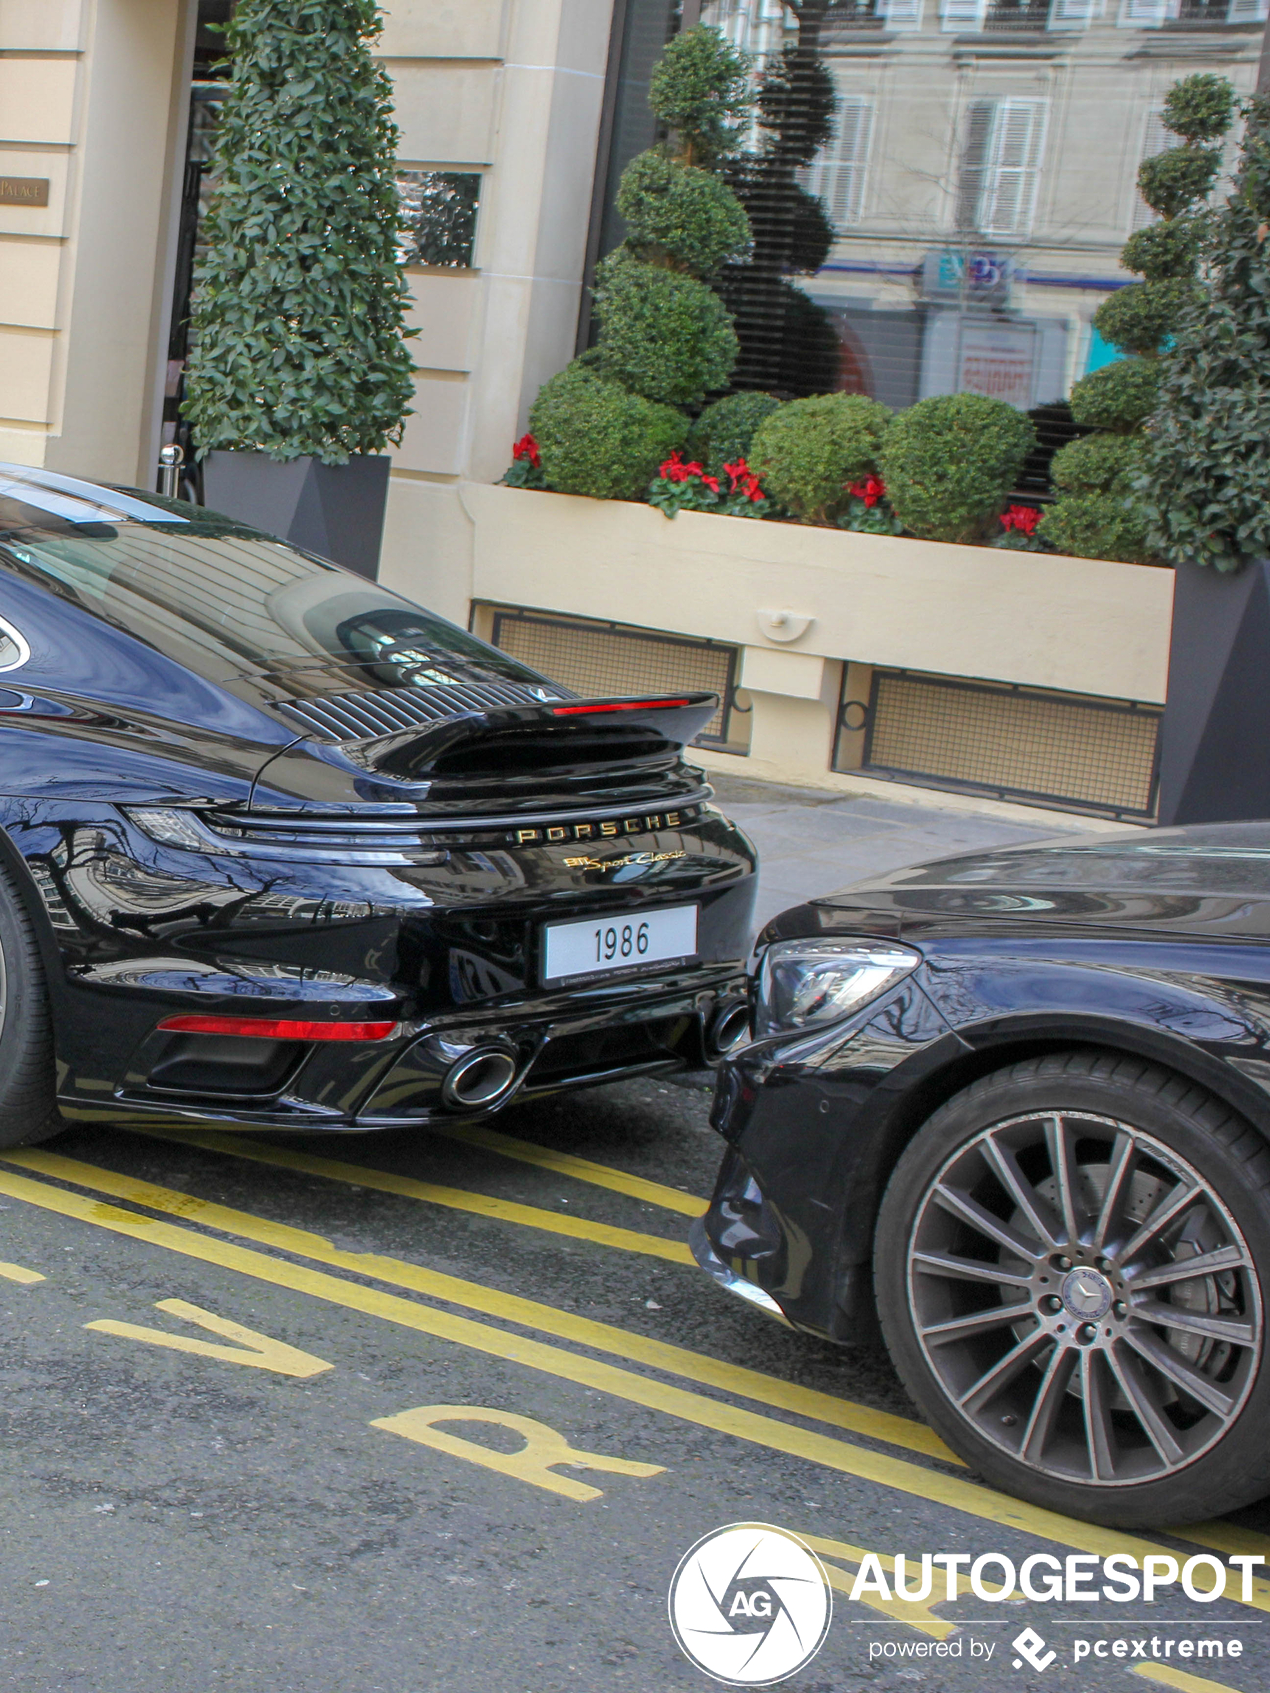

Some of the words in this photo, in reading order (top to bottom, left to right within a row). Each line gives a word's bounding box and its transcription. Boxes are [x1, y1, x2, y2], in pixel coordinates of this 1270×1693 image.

[517, 812, 680, 843] PORSCHE
[563, 856, 591, 868] 911
[584, 855, 633, 873] Sport
[636, 849, 687, 865] Classic
[595, 922, 650, 963] 1986
